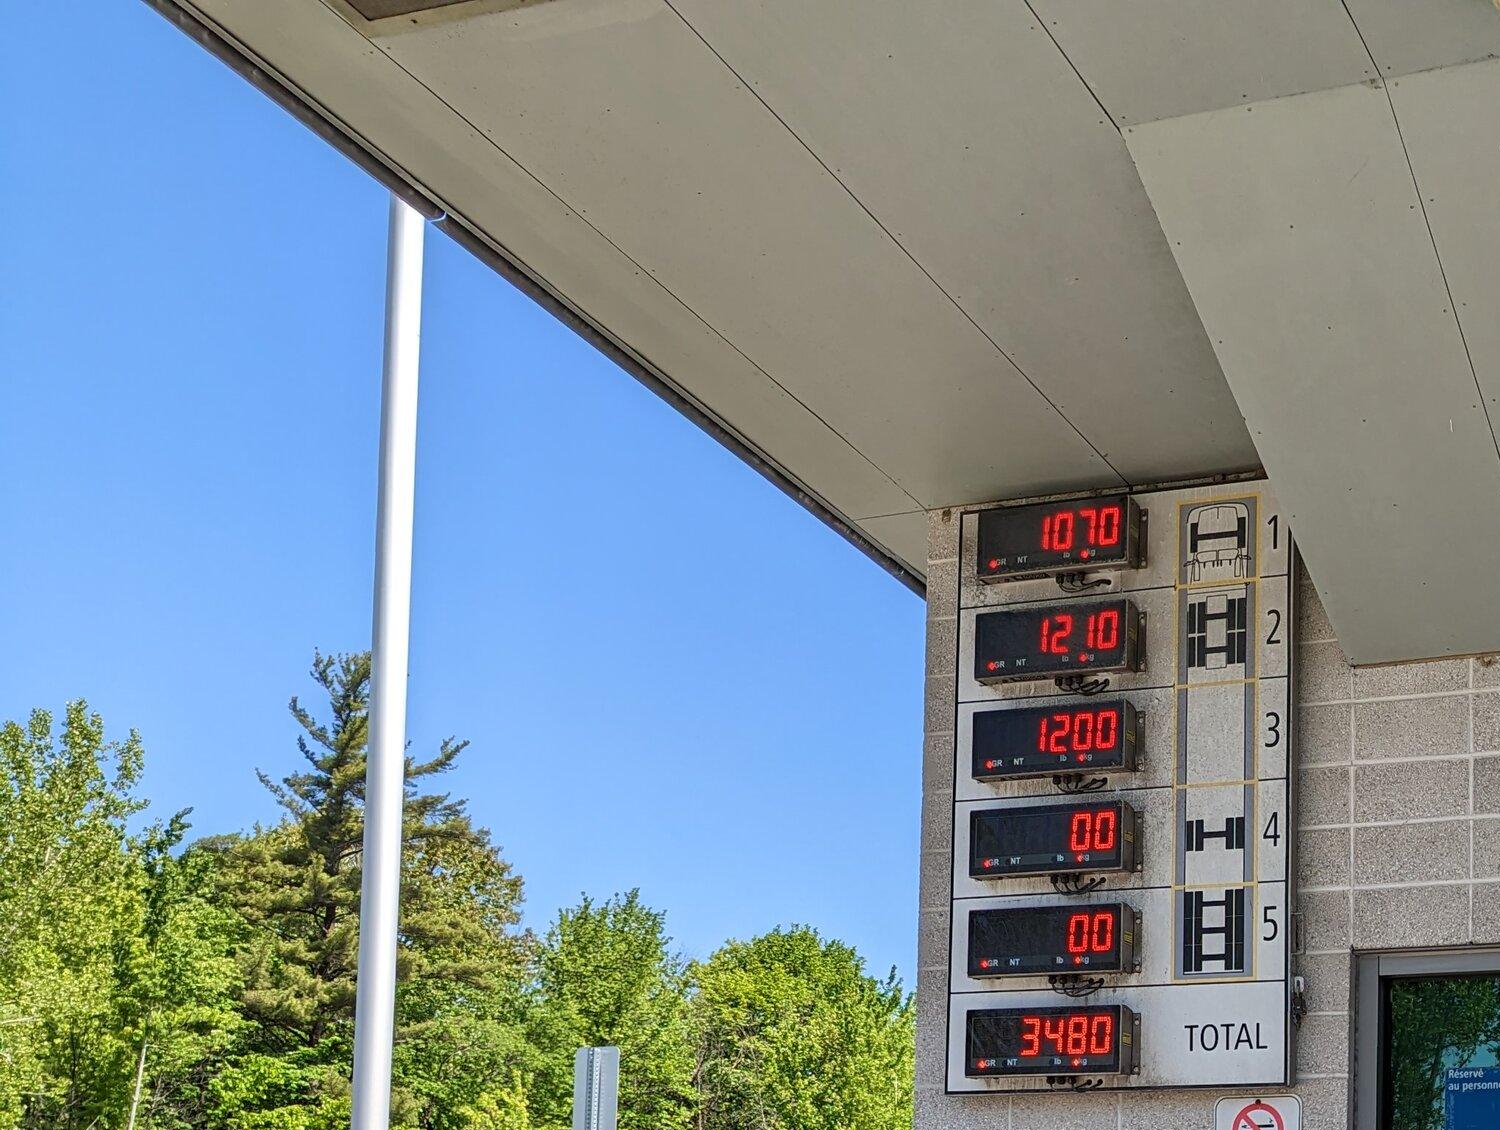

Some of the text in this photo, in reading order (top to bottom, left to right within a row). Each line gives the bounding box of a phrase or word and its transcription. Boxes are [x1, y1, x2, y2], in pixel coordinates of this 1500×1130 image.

[1043, 507, 1120, 551] 1070
[1267, 514, 1278, 550] 1
[996, 558, 1007, 566] GR
[1017, 555, 1028, 563] NT
[1041, 611, 1118, 653] 1210
[1266, 609, 1281, 645] 2
[994, 661, 1005, 669] GR
[1016, 658, 1027, 667] NT
[1039, 711, 1117, 753] 1200
[1264, 711, 1280, 748] 3
[992, 759, 1003, 767] GR
[1014, 757, 1024, 765] NT
[1071, 811, 1115, 851] 00
[1262, 811, 1281, 847] 4
[988, 858, 999, 866] GR
[1263, 905, 1278, 942] 5
[1068, 913, 1113, 953] 00
[987, 959, 999, 967] GR
[1009, 958, 1020, 966] NT
[1021, 1016, 1112, 1056] 3480
[1184, 1022, 1268, 1052] TOTAL
[984, 1059, 996, 1067] GR
[1007, 1058, 1017, 1066] NT
[1448, 1068, 1484, 1079] Réservé
[1448, 1083, 1460, 1091] au
